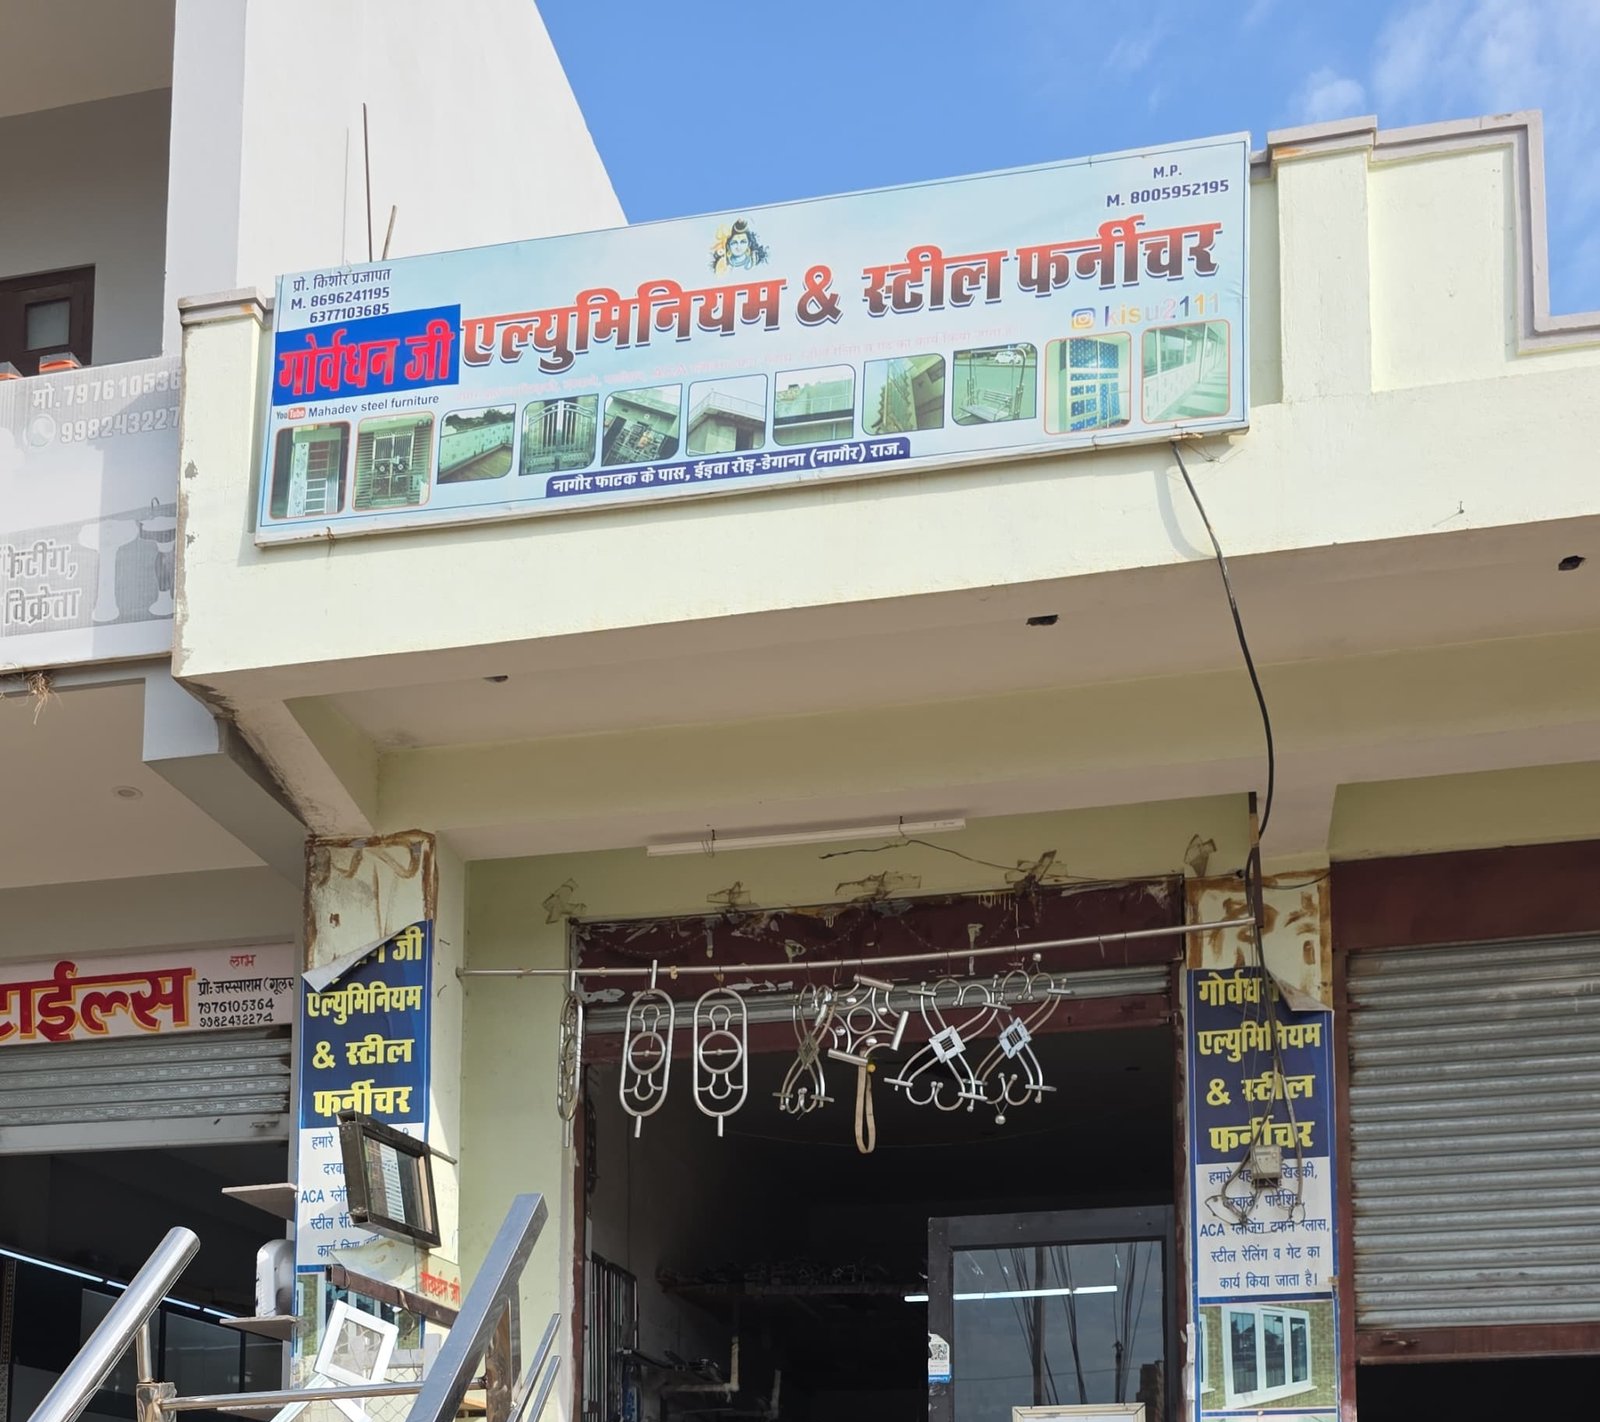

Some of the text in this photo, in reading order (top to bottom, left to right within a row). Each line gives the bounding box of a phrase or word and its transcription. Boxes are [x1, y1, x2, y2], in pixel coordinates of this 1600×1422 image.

[1153, 164, 1182, 179] M.P.
[1106, 179, 1230, 208] M. 8005952195
[293, 269, 392, 293] प्रो. किशोर प्रजापत
[291, 287, 389, 310] M. 8696241195
[405, 319, 455, 380] जी
[460, 278, 788, 375] एल्युमिनियम
[796, 265, 842, 327] &
[861, 245, 1009, 319] स्टील
[1016, 214, 1223, 299] फर्नीचर
[310, 303, 389, 323] 6377103685
[308, 405, 358, 418] Mahadev
[361, 400, 387, 411] steel
[391, 395, 439, 408] furniture
[552, 473, 593, 493] नागौर
[595, 471, 638, 488] फाटक
[641, 467, 656, 484] के
[658, 466, 691, 481] पास,
[810, 444, 867, 467] (नागौर)
[870, 442, 905, 458] राज.
[4, 584, 82, 625] विक्रेता
[391, 925, 424, 961] जी
[229, 954, 256, 968] लाभ
[198, 997, 274, 1014] 7976105364
[307, 980, 423, 1025] एल्युमिनियम
[200, 1012, 273, 1027] 9982432274
[312, 1033, 415, 1070] & स्टील
[1197, 1020, 1322, 1063] एल्युमिनियम
[313, 1079, 413, 1117] फर्नीचर
[1206, 1071, 1316, 1106] & स्टील
[312, 1132, 334, 1150] हमारे
[1208, 1115, 1315, 1152] फर्नीचर
[323, 1162, 345, 1176] दरव
[1208, 1167, 1232, 1185] हमारे
[1238, 1170, 1253, 1183] यह
[301, 1189, 325, 1204] ACA
[310, 1212, 334, 1230] स्टील
[1200, 1223, 1225, 1237] ACA
[1210, 1243, 1320, 1263] स्टील रेलिंग व गेट का
[1219, 1268, 1318, 1290] कार्य किया जाता है।
